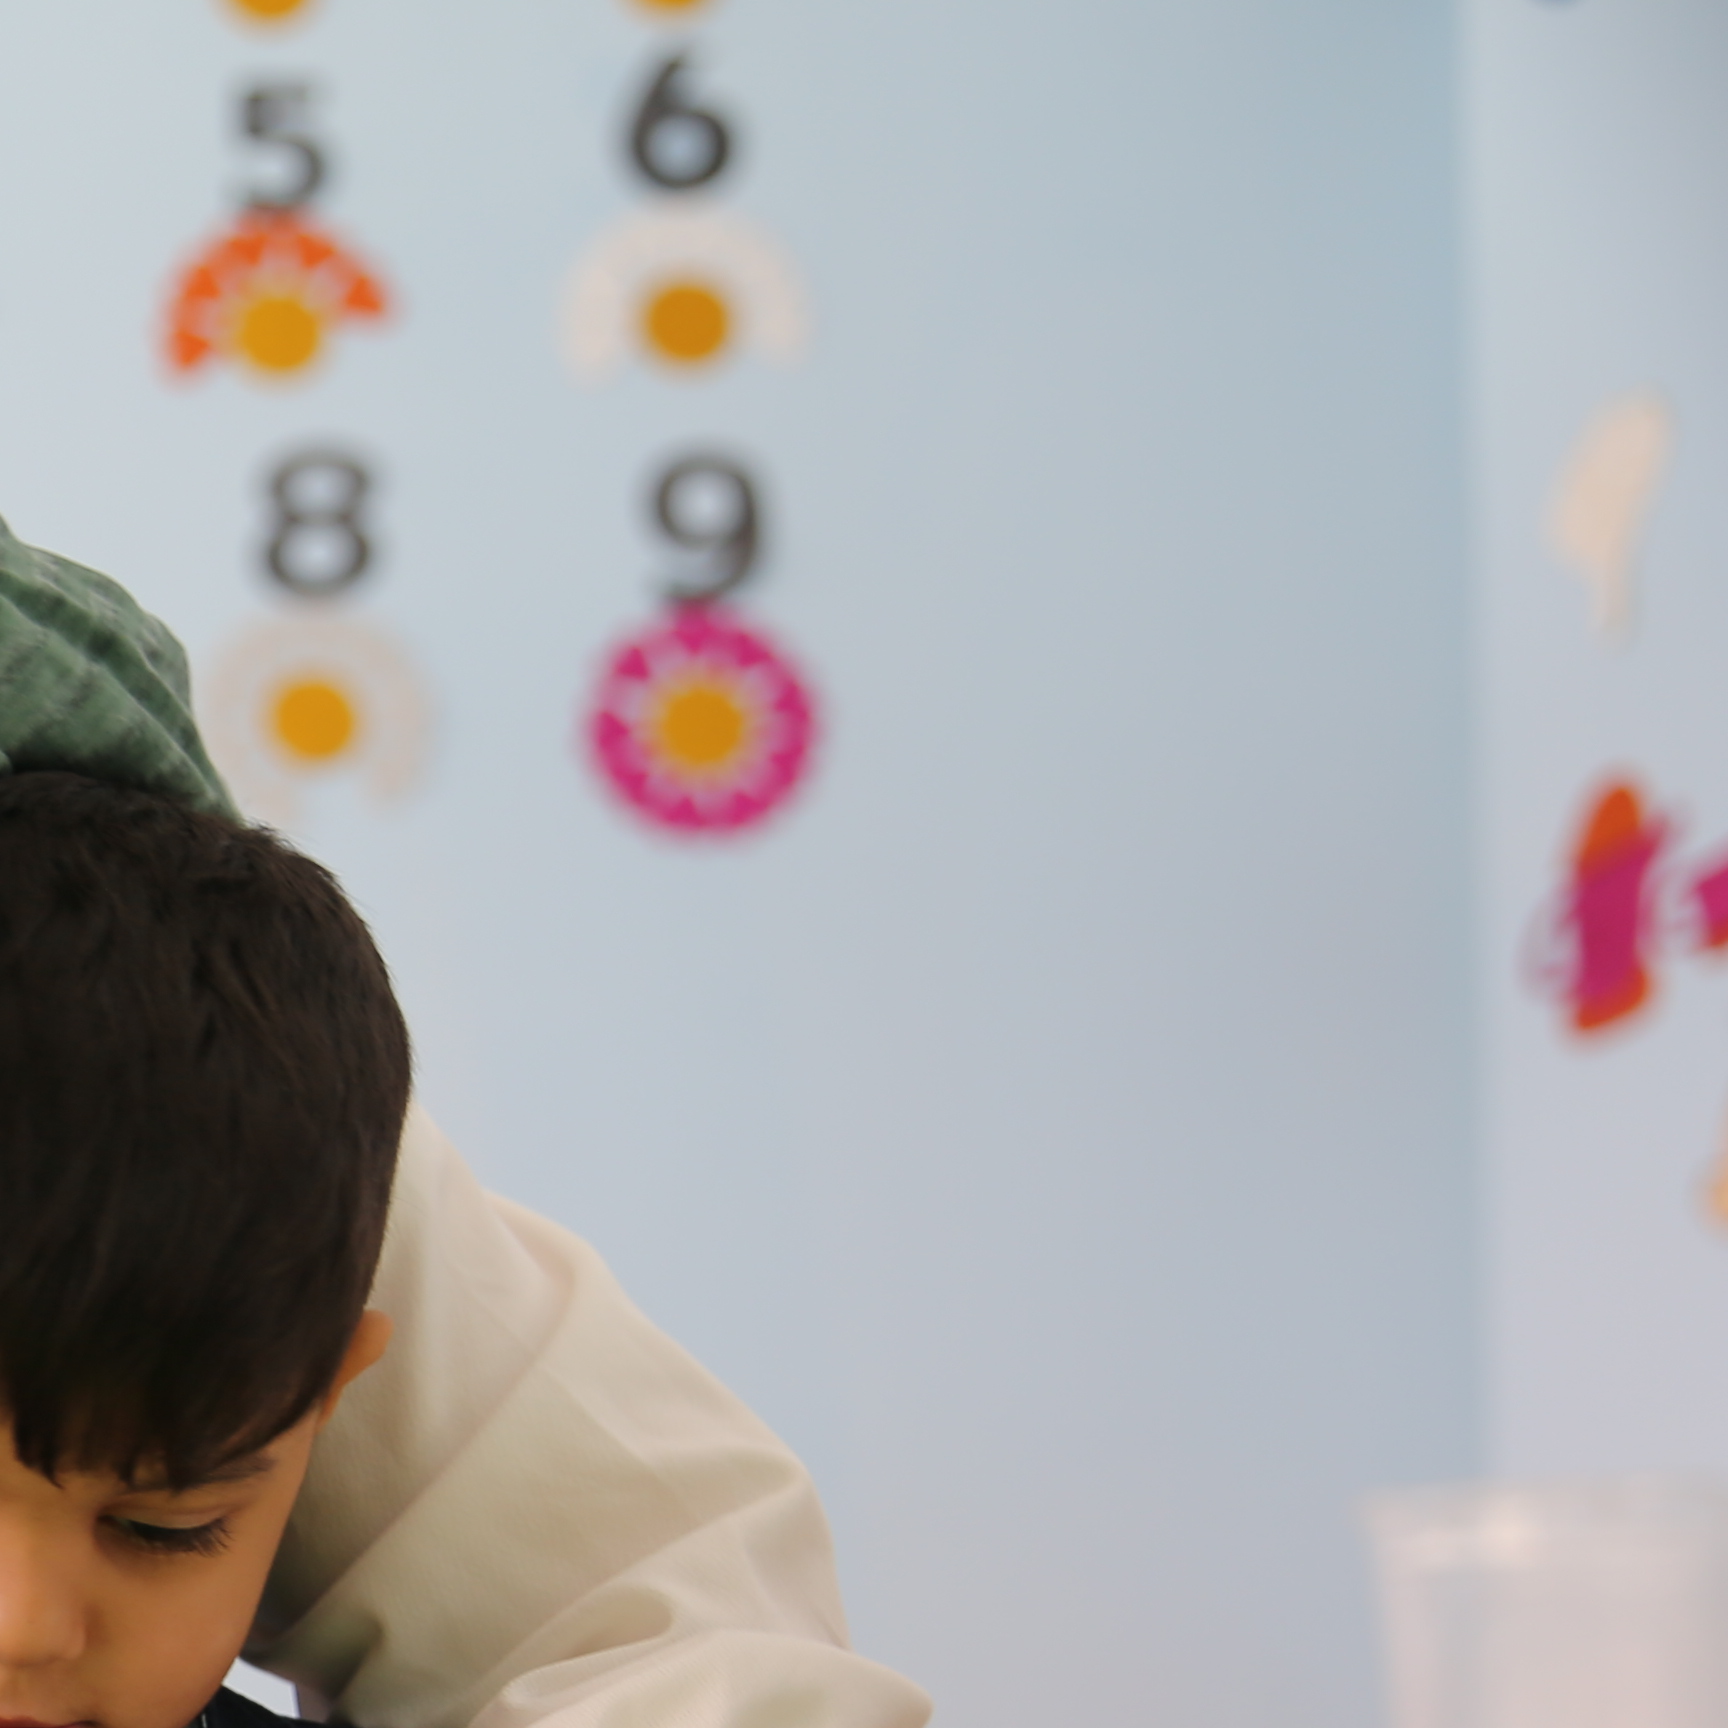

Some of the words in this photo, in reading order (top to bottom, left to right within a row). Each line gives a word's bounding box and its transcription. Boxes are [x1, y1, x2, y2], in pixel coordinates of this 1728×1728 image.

[233, 82, 330, 208] 5
[625, 48, 736, 194] 6
[261, 453, 376, 595] 8
[649, 453, 762, 605] 9
